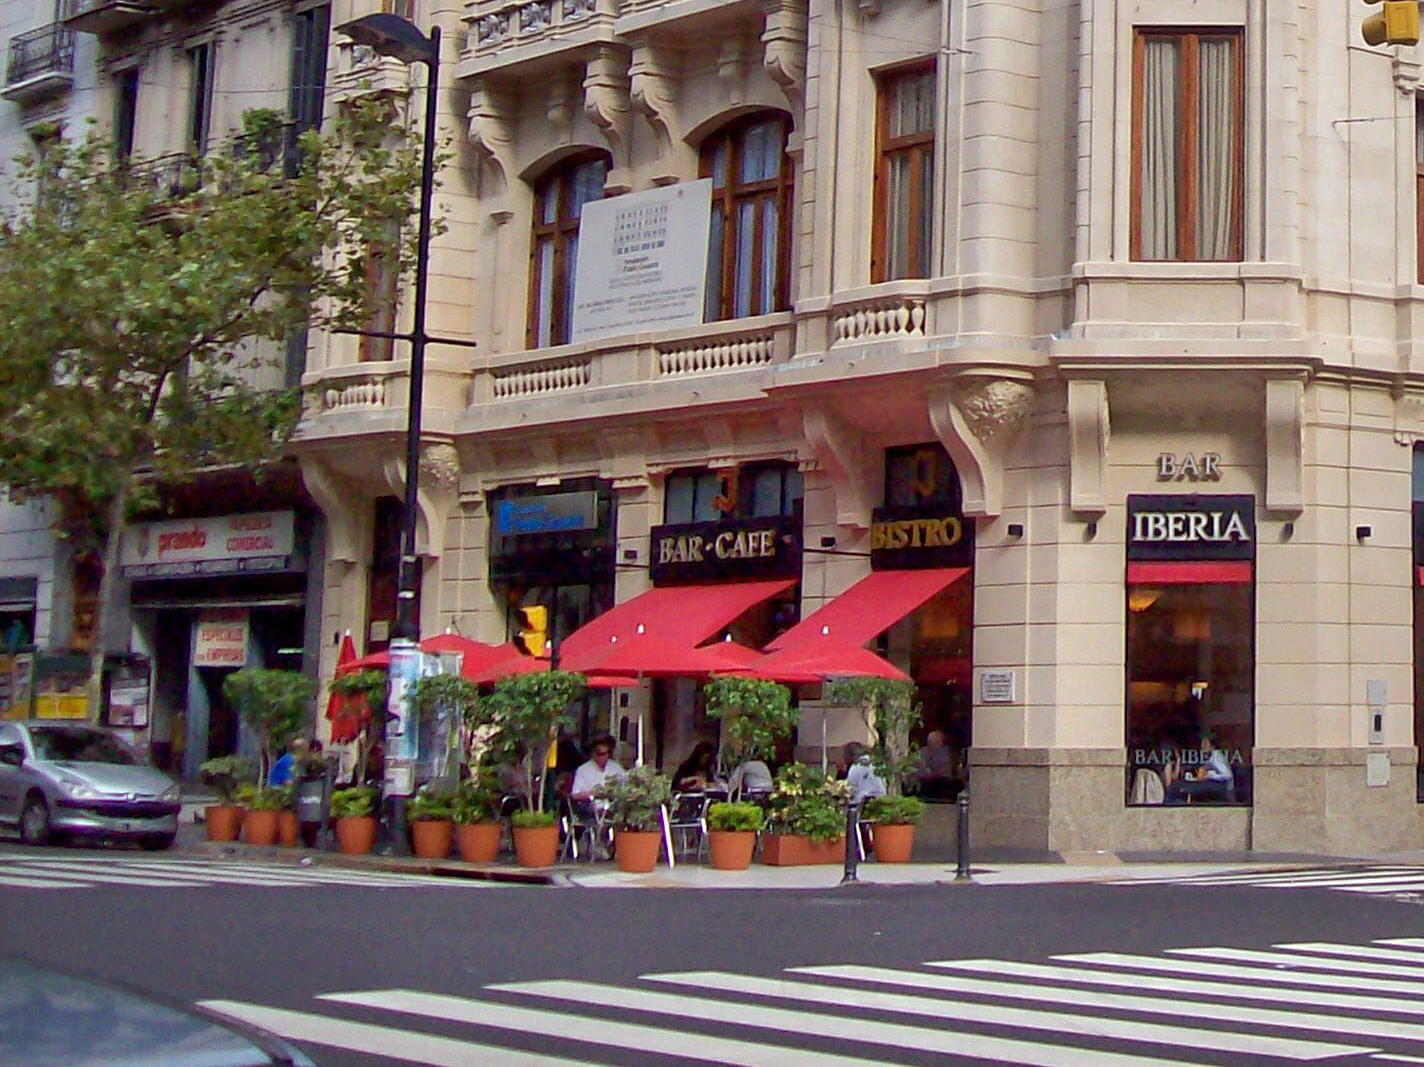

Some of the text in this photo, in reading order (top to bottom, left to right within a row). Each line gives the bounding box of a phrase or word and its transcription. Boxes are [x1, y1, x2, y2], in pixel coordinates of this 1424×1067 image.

[1160, 452, 1221, 477] BAR
[872, 517, 962, 549] BISTRO
[1133, 511, 1250, 541] IBERIA
[660, 532, 776, 564] BAR CAFE
[1134, 748, 1243, 764] BAR IBEIA
